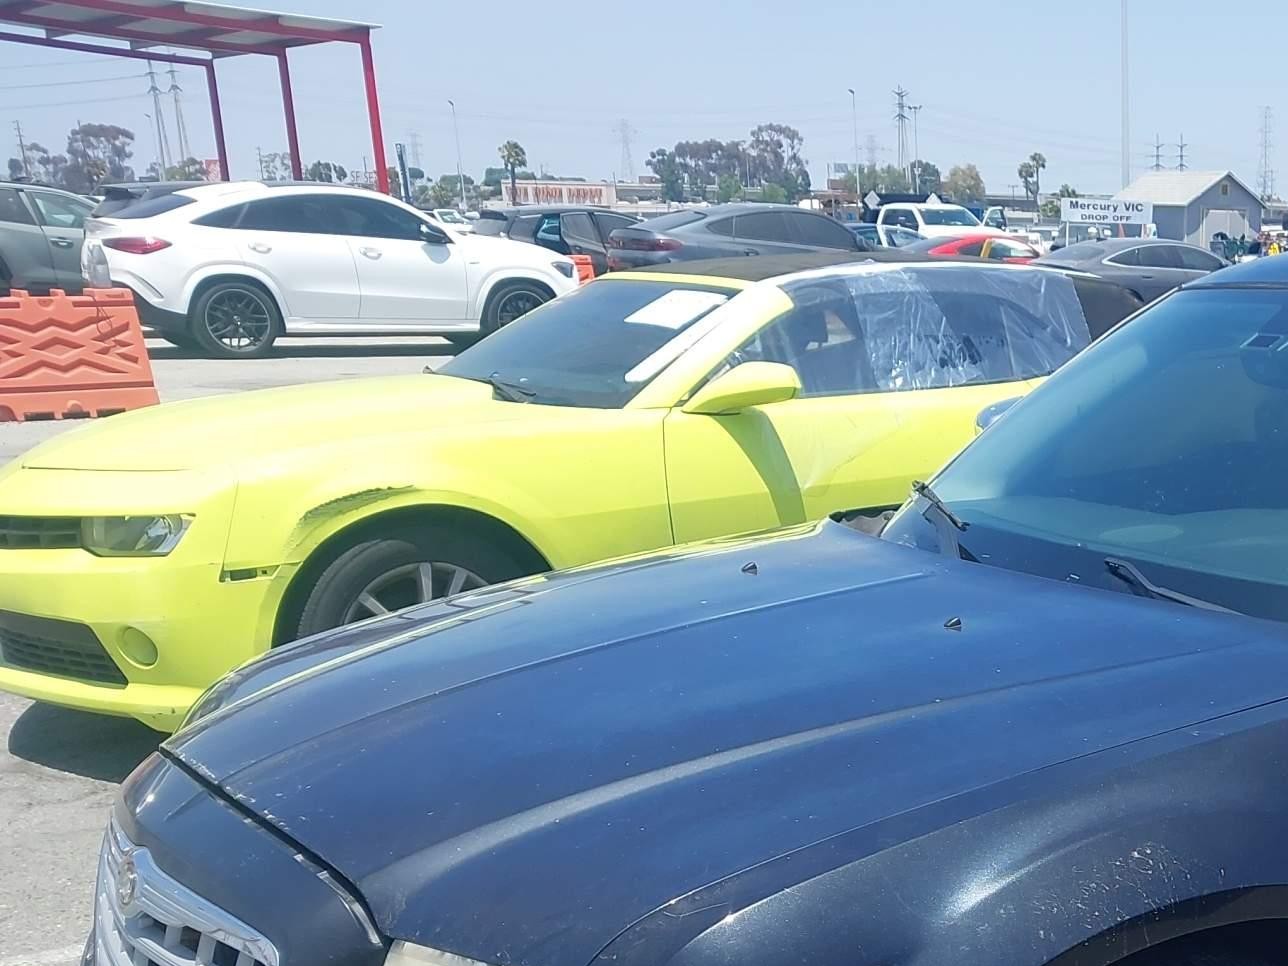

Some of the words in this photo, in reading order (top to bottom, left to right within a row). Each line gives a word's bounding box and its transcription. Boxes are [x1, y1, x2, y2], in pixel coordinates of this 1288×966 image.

[1069, 200, 1119, 213] Mercury
[1123, 202, 1145, 213] VIC
[1080, 213, 1109, 222] DROP
[1112, 214, 1133, 222] OFF
